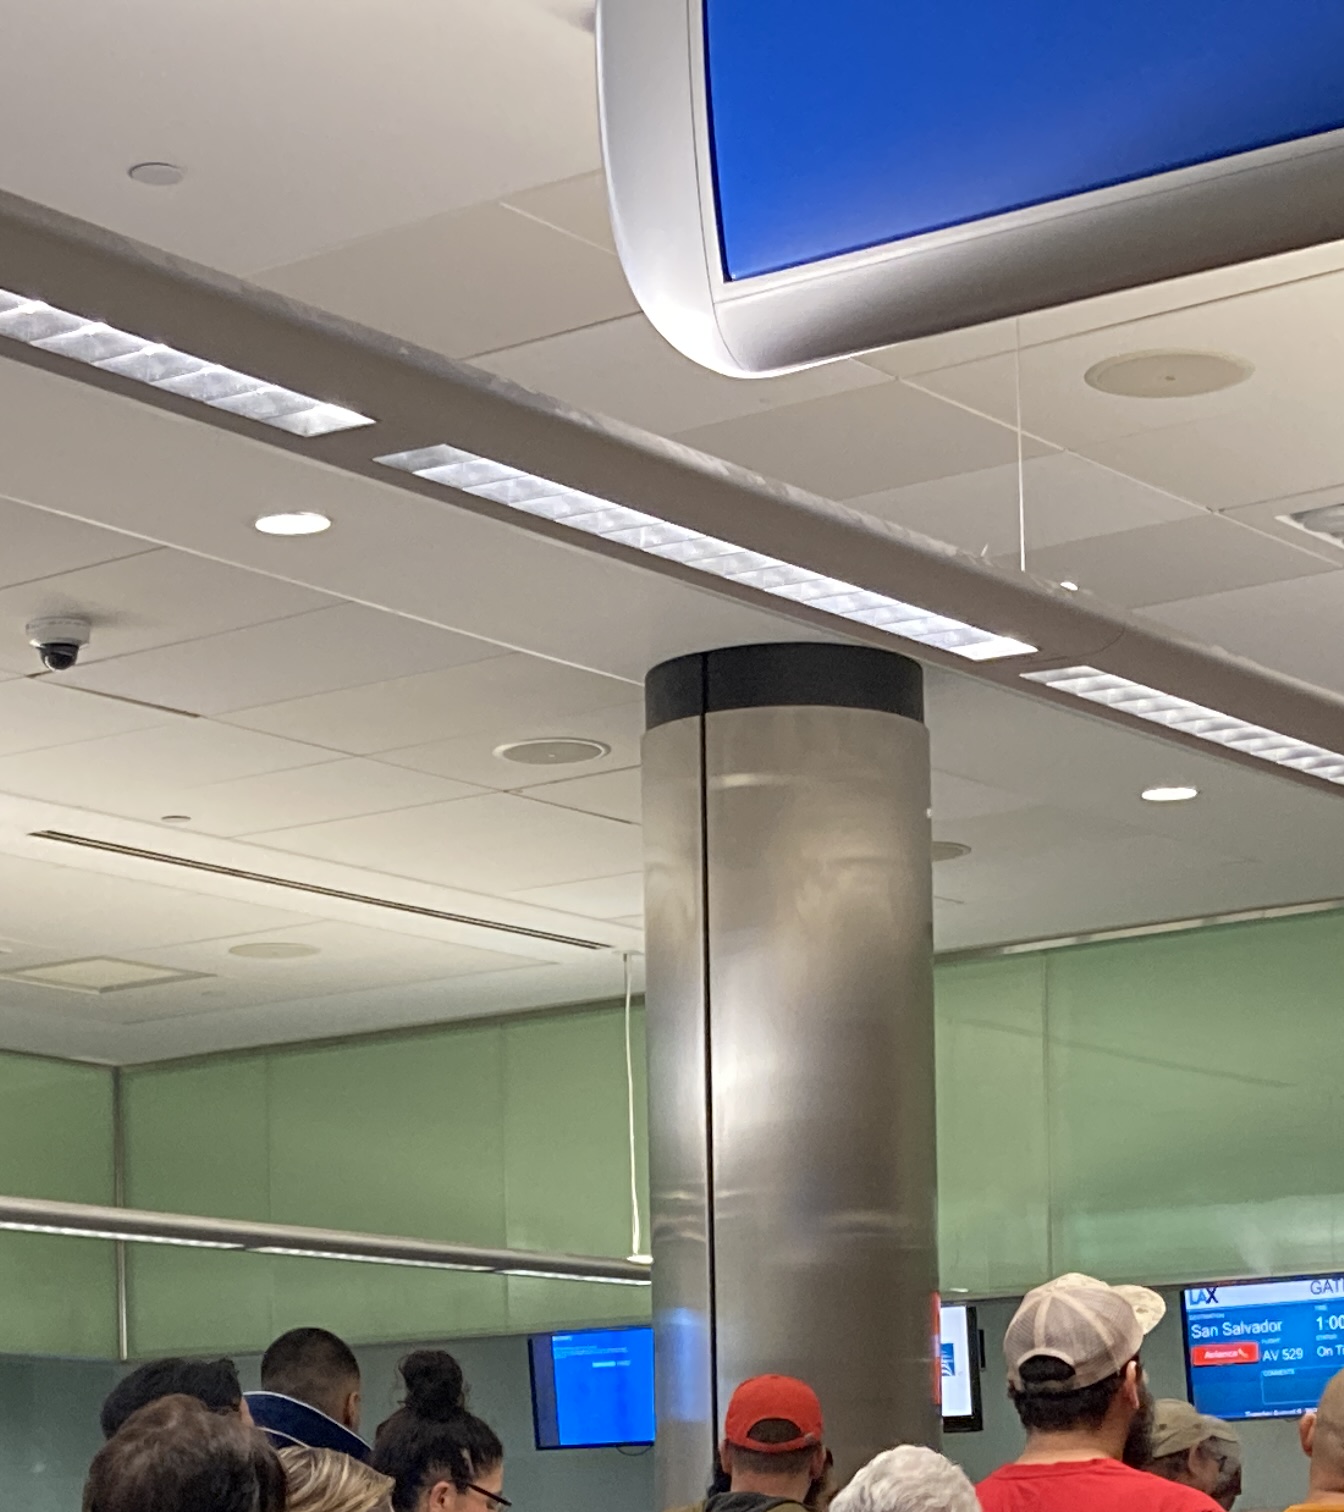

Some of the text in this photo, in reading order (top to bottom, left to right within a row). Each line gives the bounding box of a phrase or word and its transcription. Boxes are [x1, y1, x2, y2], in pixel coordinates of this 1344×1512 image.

[1189, 1285, 1219, 1305] LAX
[1190, 1319, 1283, 1339] San Salvador
[1262, 1347, 1304, 1361] AV 529
[1316, 1346, 1334, 1357] On
